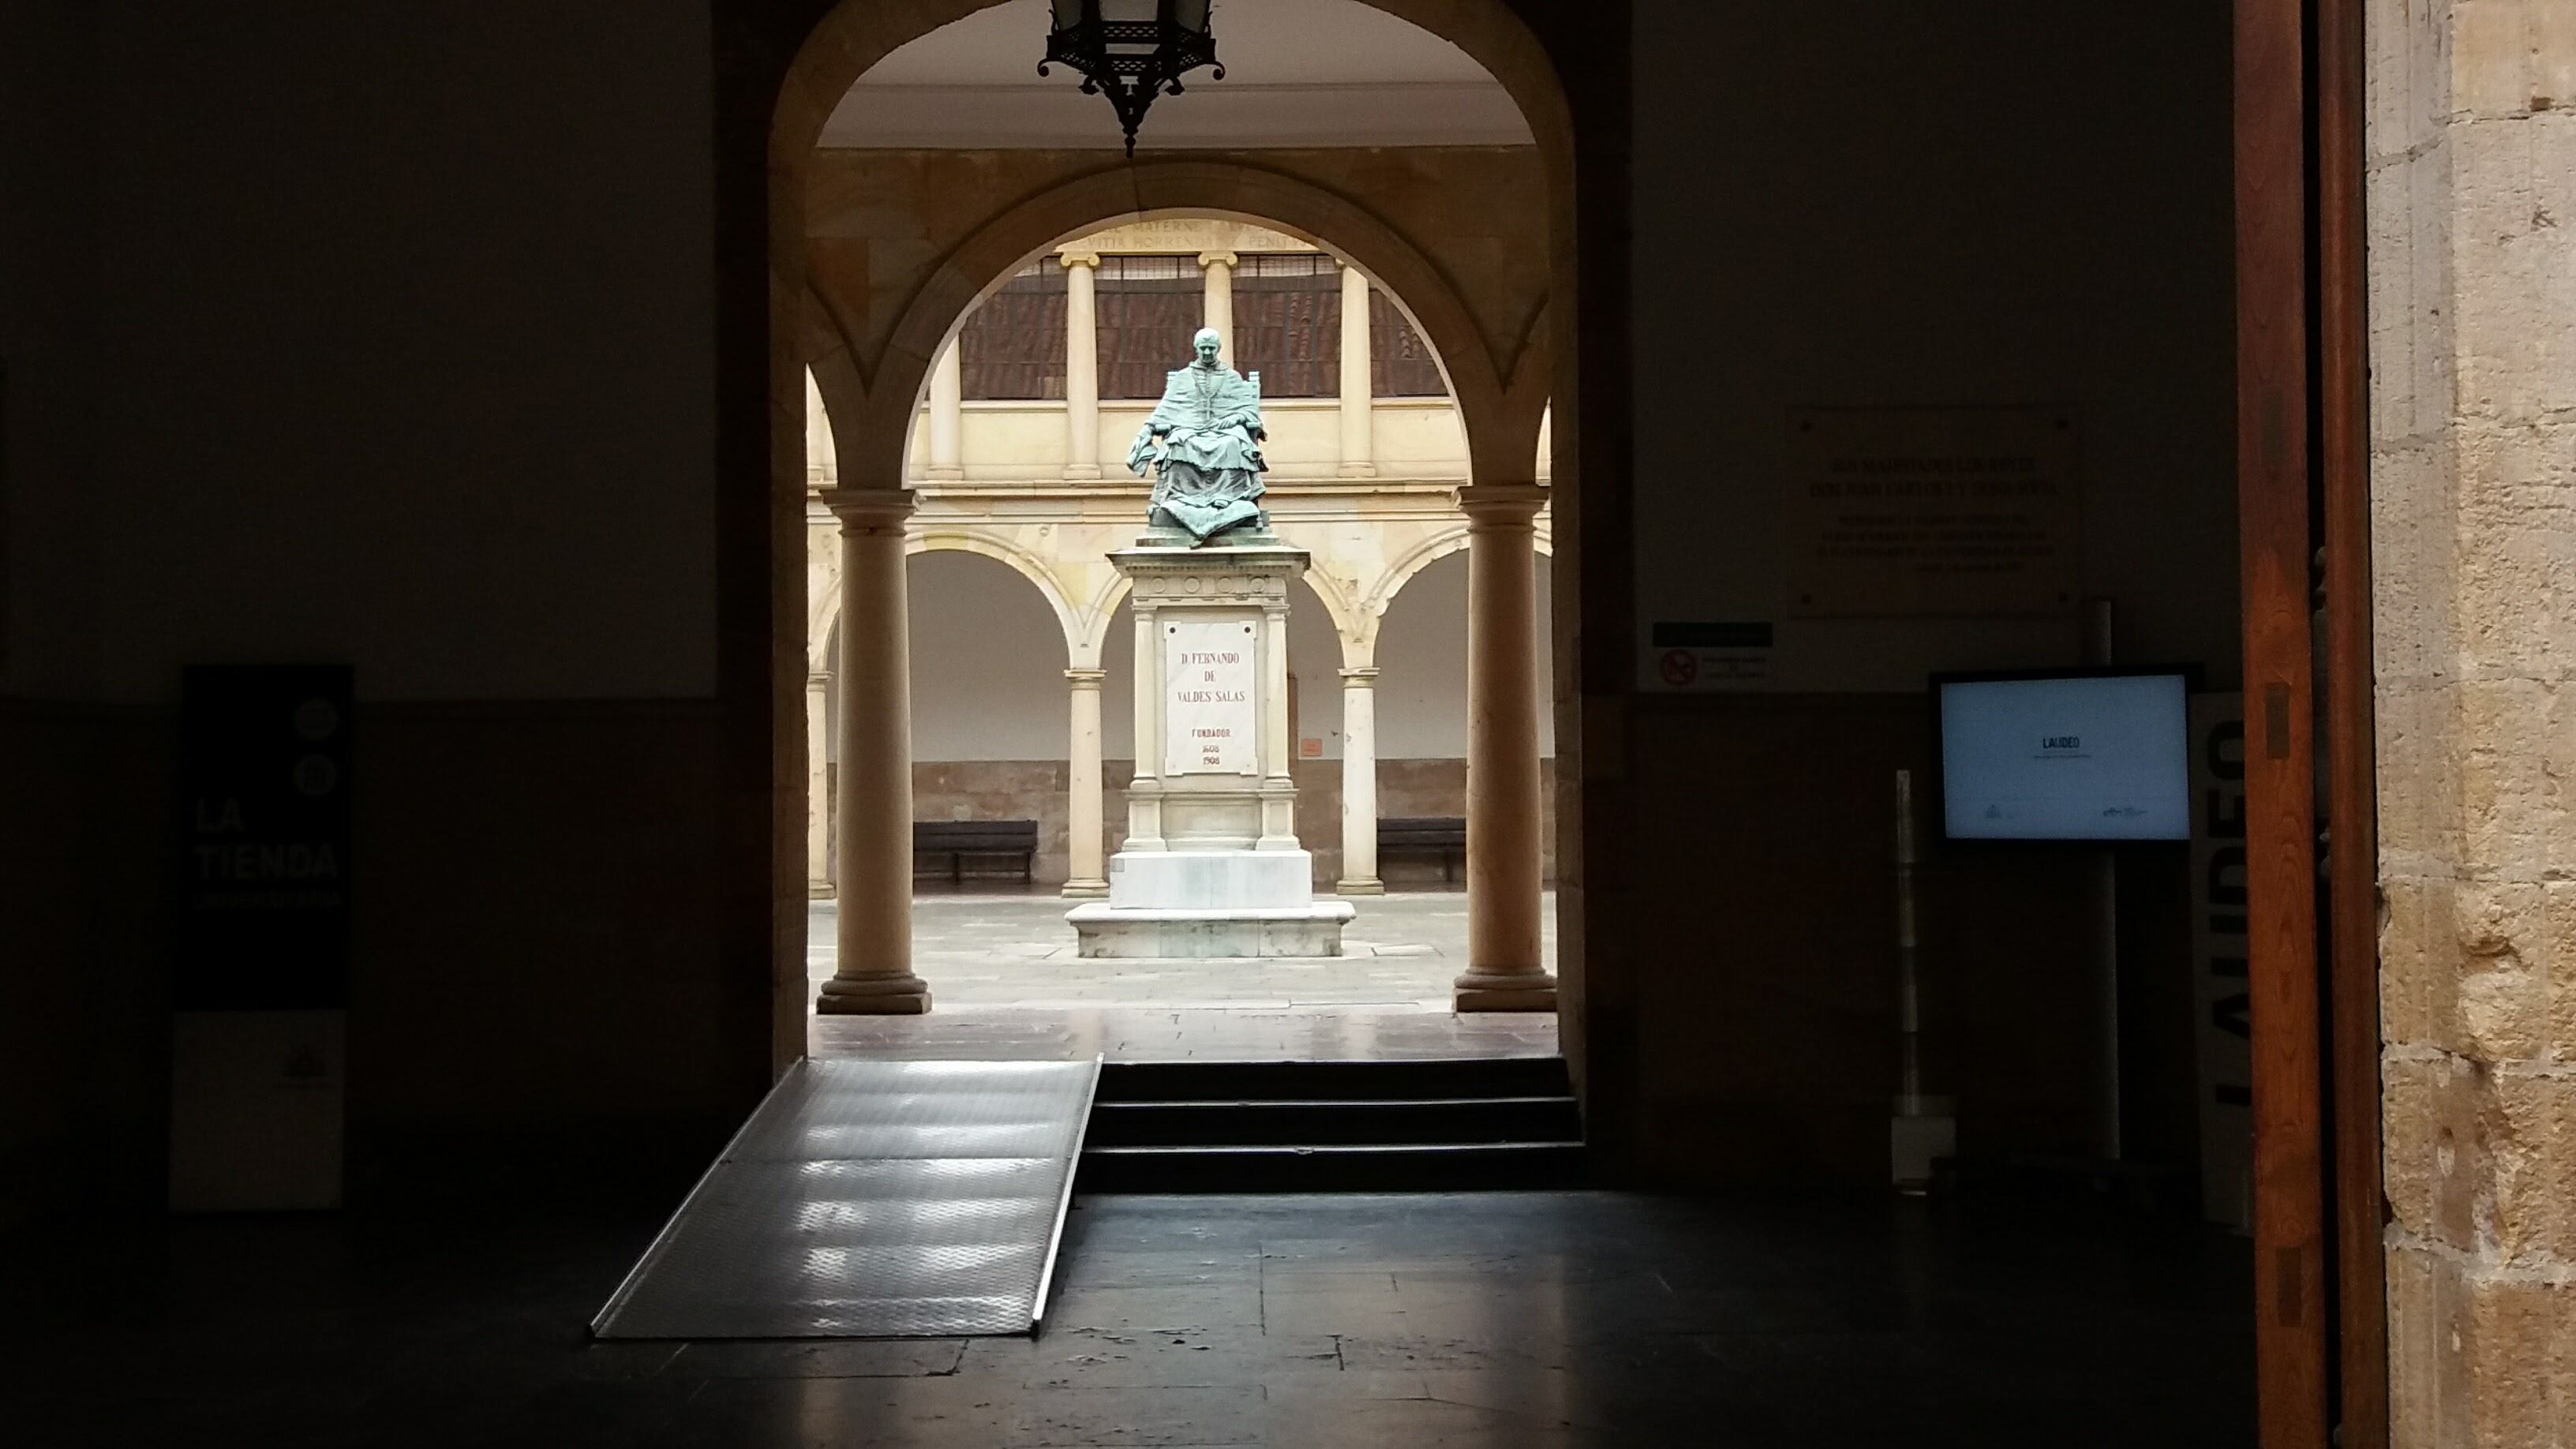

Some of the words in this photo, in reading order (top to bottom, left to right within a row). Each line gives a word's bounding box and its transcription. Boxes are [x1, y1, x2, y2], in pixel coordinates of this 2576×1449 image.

[1192, 653, 1240, 665] FERNANDO
[1204, 671, 1216, 682] DE
[1178, 691, 1211, 702] VALDES
[1215, 690, 1245, 702] SALAS
[1192, 728, 1231, 738] FUNDADOR
[2042, 736, 2080, 749] LAUDEO
[196, 797, 246, 833] LA
[193, 843, 339, 878] TIENDA
